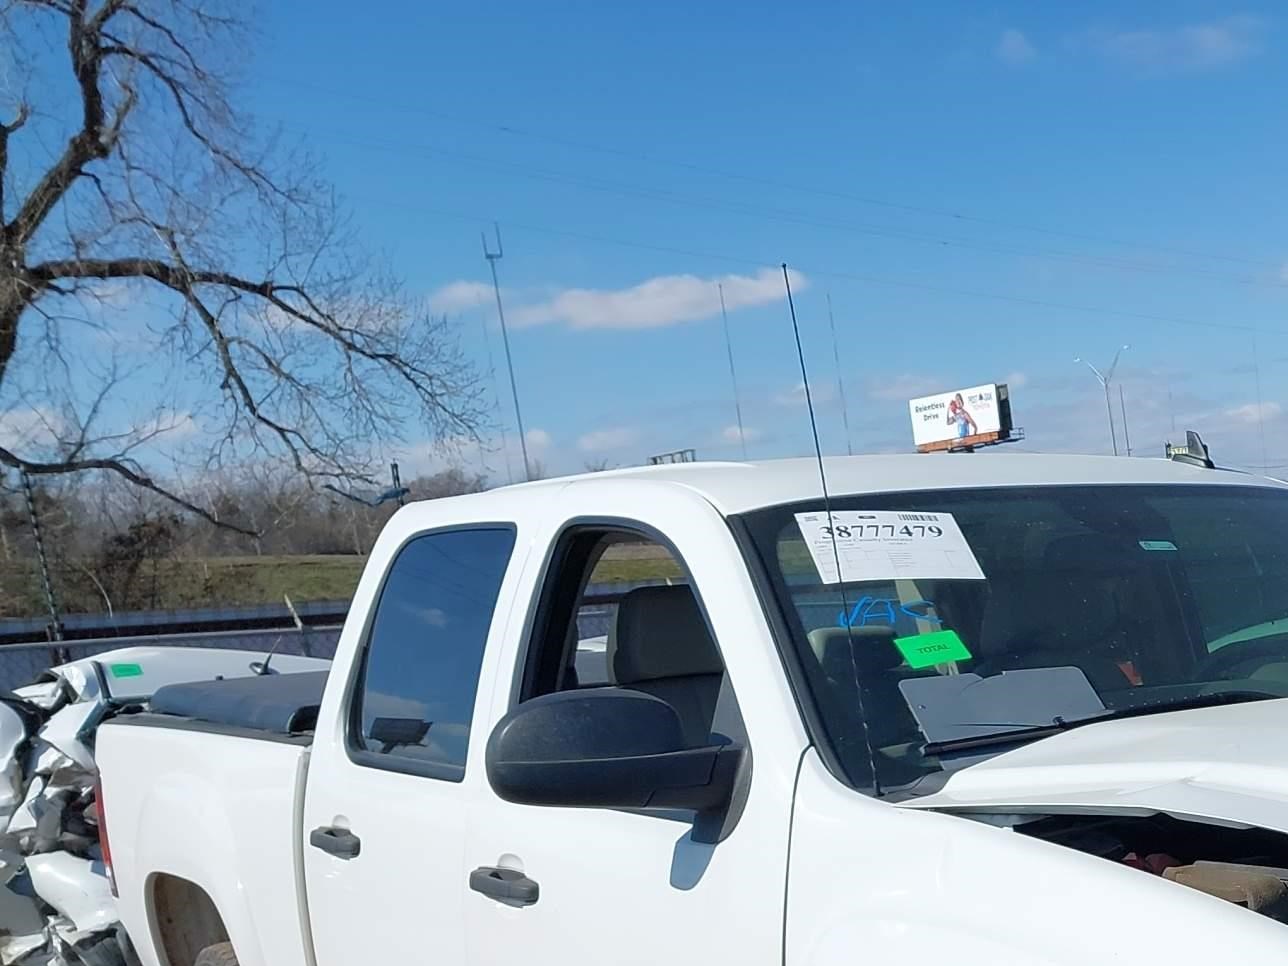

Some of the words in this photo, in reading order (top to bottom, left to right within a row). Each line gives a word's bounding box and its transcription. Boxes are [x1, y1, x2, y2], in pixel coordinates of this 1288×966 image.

[915, 402, 945, 413] Relentless
[923, 413, 939, 421] Drive
[819, 525, 943, 540] 38777479
[916, 643, 951, 656] TOTAL
